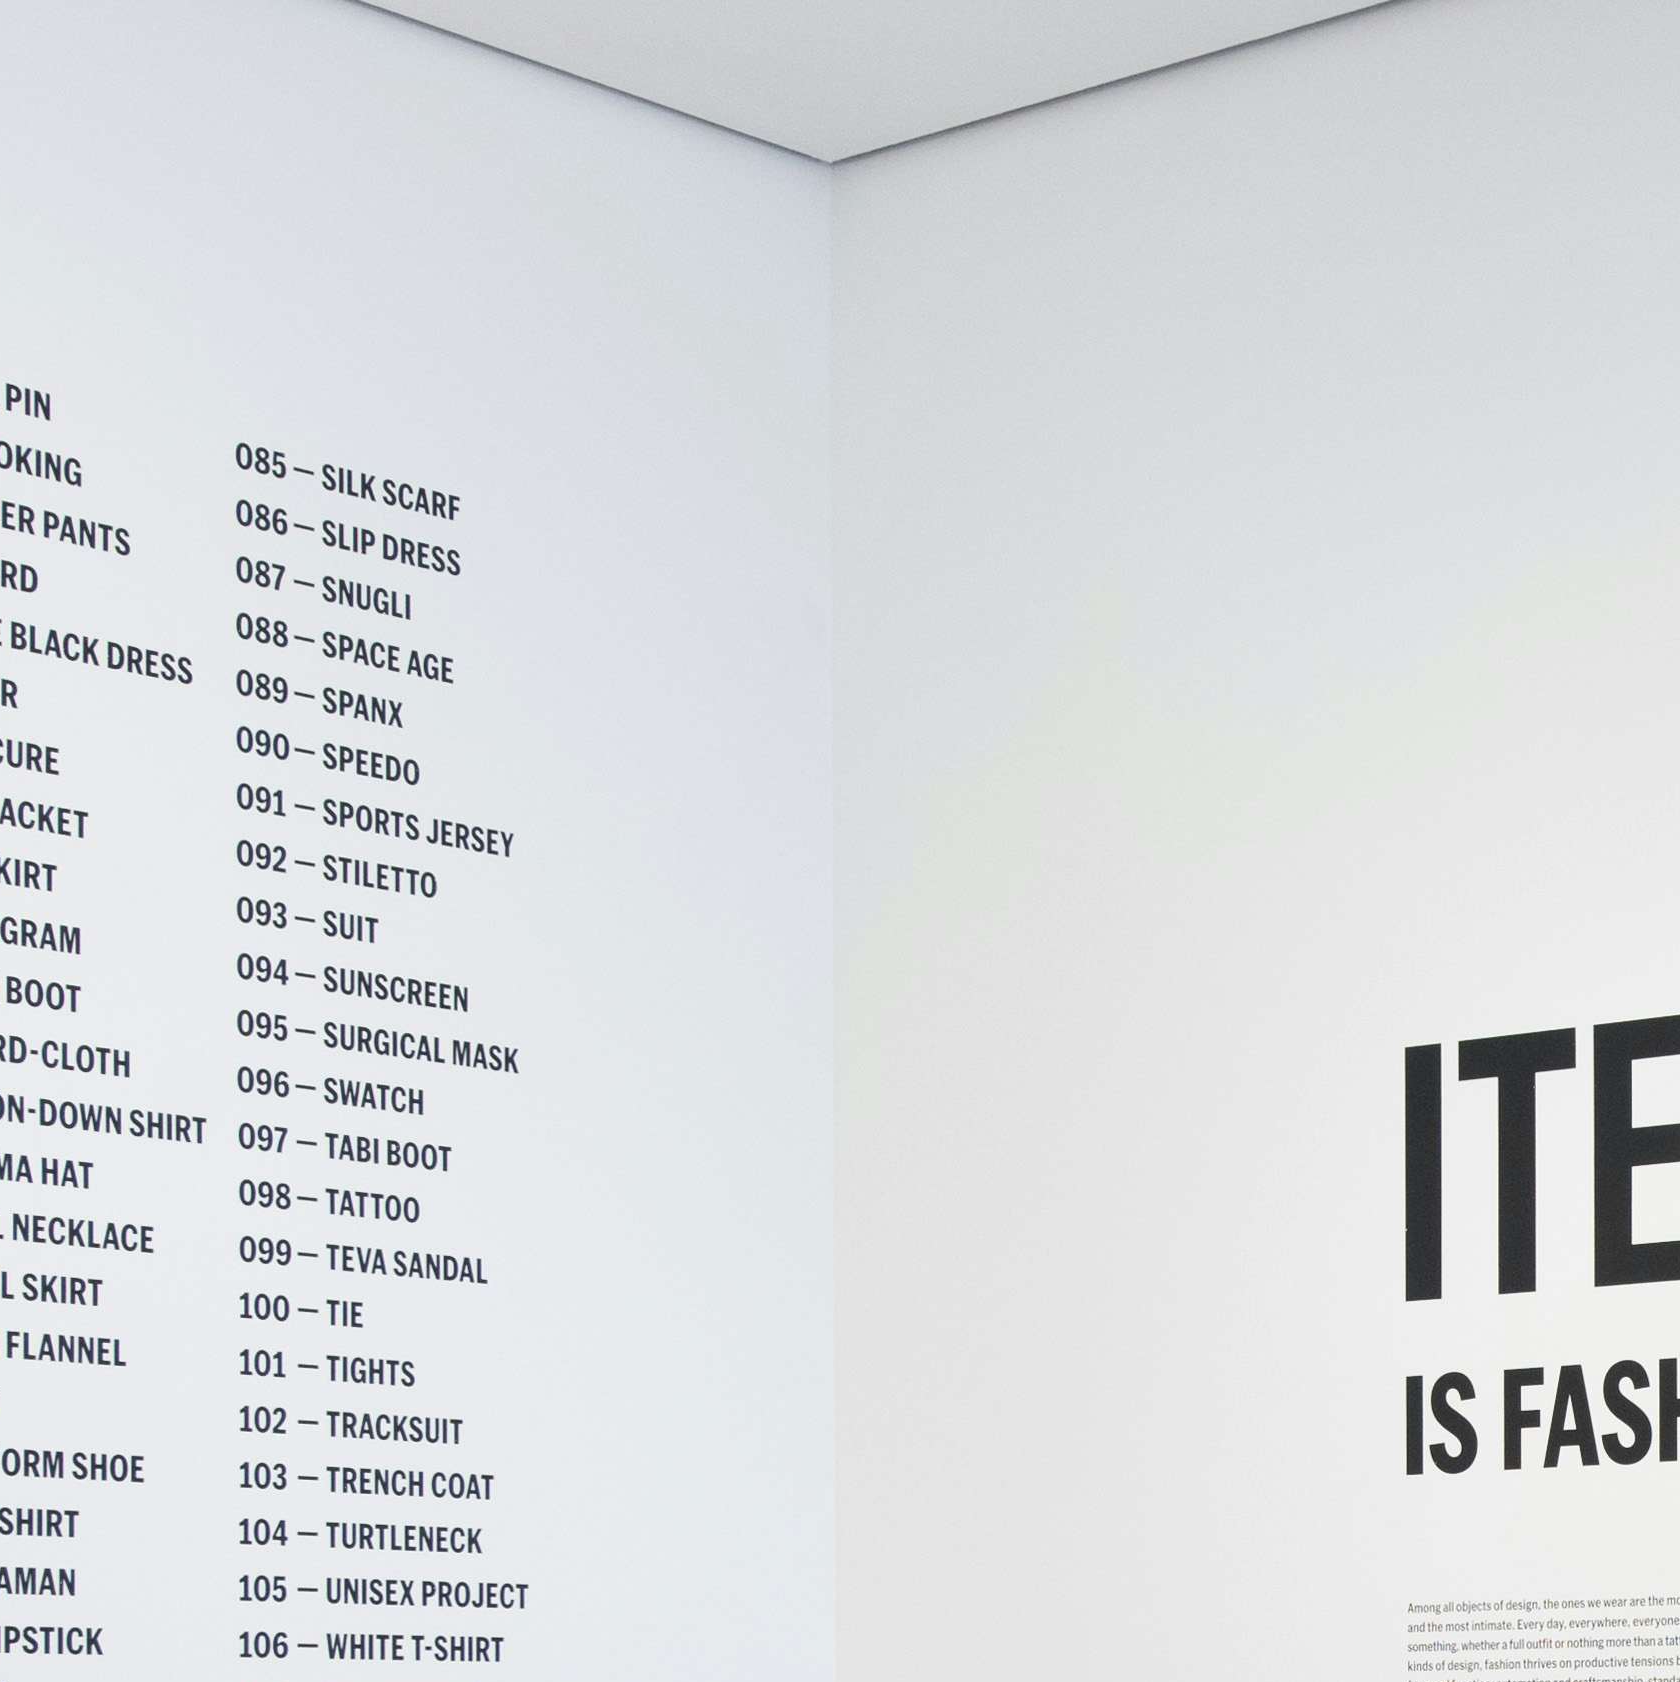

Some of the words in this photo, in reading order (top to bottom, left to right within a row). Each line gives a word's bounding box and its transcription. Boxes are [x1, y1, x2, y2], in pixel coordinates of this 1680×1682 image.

[6, 383, 50, 421] PIN
[236, 443, 286, 478] 085
[322, 464, 376, 501] SILK
[383, 479, 460, 520] SCARF
[44, 511, 130, 555] PANTS
[236, 669, 288, 703] 089
[323, 687, 402, 728] SPANX
[237, 896, 287, 929] 093
[323, 911, 379, 943] SUIT
[239, 1123, 288, 1153] 097
[325, 1133, 379, 1164] TABI
[387, 1140, 452, 1171] BOOT
[22, 1273, 103, 1306] SKIRT
[240, 1293, 289, 1321] 100
[326, 1300, 363, 1328] TIE
[1406, 1372, 1478, 1475] IS
[240, 1462, 287, 1490] 103
[326, 1466, 423, 1497] TRENCH
[432, 1472, 494, 1500] COAT
[1407, 1602, 1442, 1616] Among
[1442, 1601, 1455, 1613] all
[1455, 1600, 1493, 1615] objects
[1493, 1599, 1504, 1612] of
[1505, 1599, 1542, 1614] design,
[1543, 1598, 1560, 1610] the
[1561, 1599, 1586, 1610] ones
[1586, 1599, 1602, 1609] we
[1602, 1597, 1628, 1608] wear
[1629, 1597, 1647, 1608] are
[1647, 1593, 1665, 1609] the
